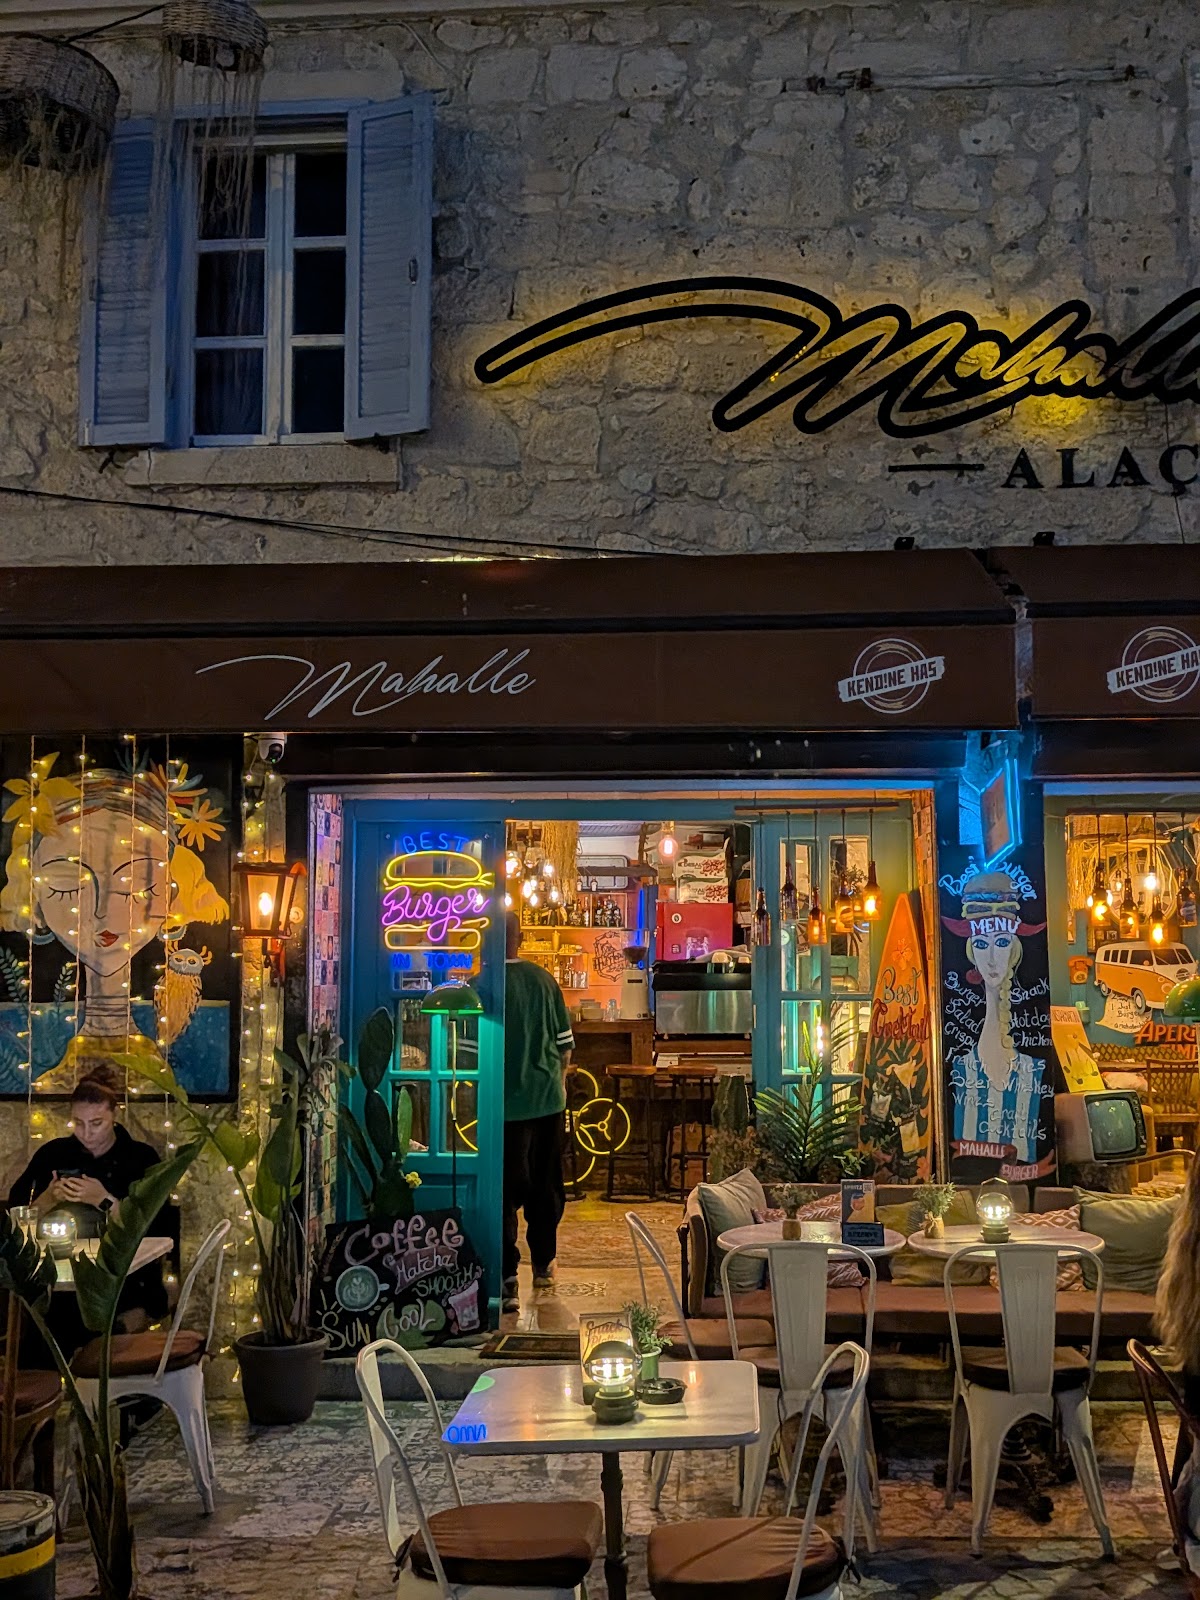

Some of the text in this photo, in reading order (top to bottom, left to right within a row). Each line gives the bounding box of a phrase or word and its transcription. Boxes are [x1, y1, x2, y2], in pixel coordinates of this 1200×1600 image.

[910, 661, 938, 683] HAS
[1180, 649, 1200, 671] HA
[196, 648, 536, 720] Mahalle
[402, 832, 469, 853] BEST
[381, 885, 490, 941] Burger
[392, 952, 472, 968] IN TOWN
[879, 966, 922, 1006] Best
[945, 971, 987, 1007] Burger
[1010, 977, 1050, 1004] Snack
[945, 999, 985, 1035] Salad
[948, 1069, 991, 1090] Beer
[343, 1214, 465, 1266] Coffee
[396, 1246, 455, 1284] Matcha
